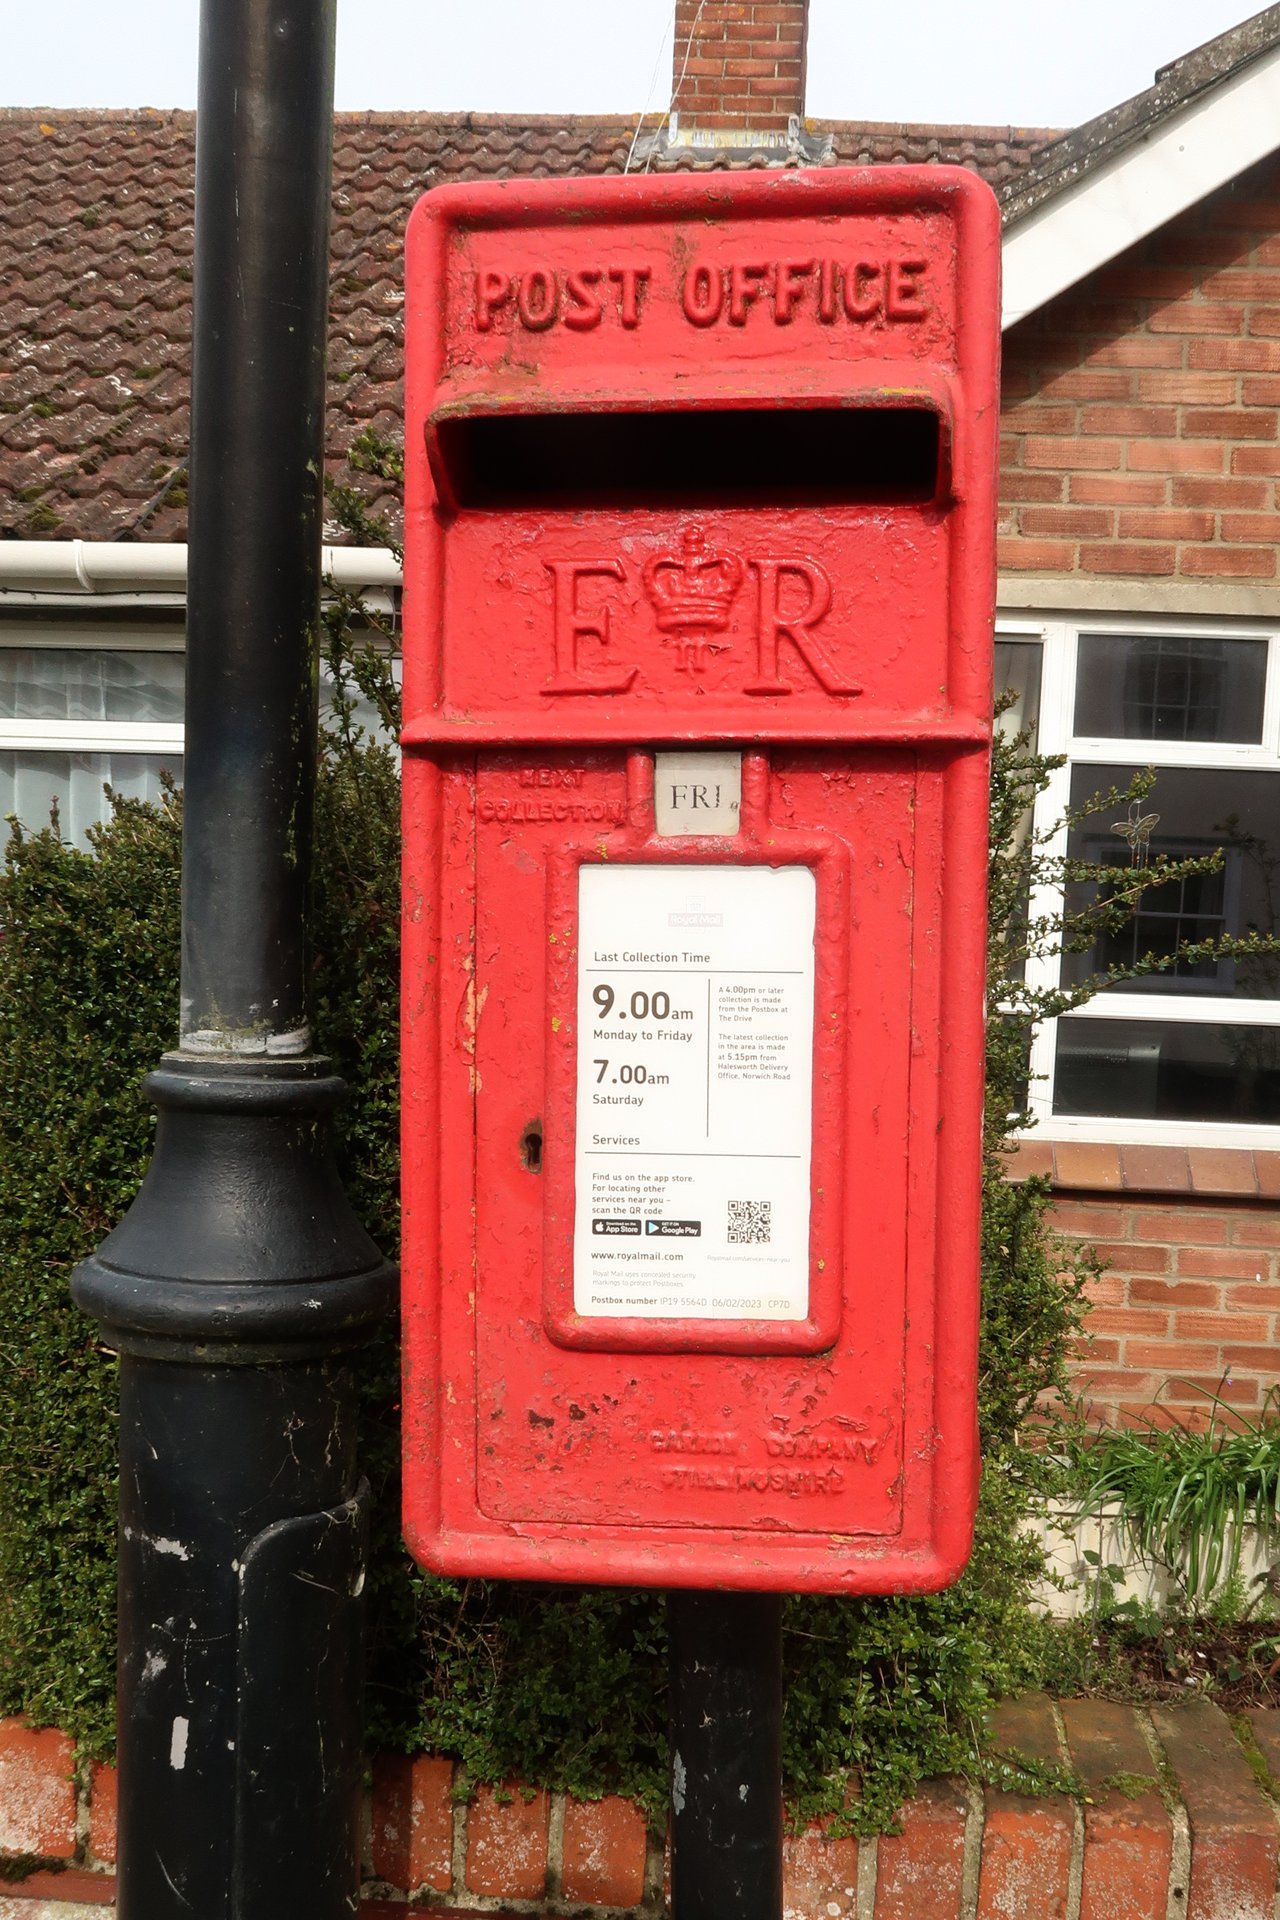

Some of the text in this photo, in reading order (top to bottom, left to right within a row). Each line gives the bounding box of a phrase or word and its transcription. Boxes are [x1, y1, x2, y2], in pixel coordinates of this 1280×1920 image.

[475, 258, 930, 333] POST OFFICE
[540, 556, 863, 697] E R
[519, 769, 585, 788] NEXT
[670, 784, 721, 809] FRI
[477, 799, 625, 824] COLLECTION
[594, 952, 711, 963] Last Collection Time
[725, 985, 756, 995] 4.00pm
[592, 984, 694, 1020] 9.00am
[733, 1014, 753, 1022] Drive
[593, 1030, 693, 1042] Monday to Friday
[727, 1052, 758, 1062] 5.15pm
[592, 1059, 670, 1085] 7.00am
[760, 1063, 788, 1072] Delivery
[742, 1072, 771, 1080] Norwich
[592, 1094, 644, 1106] Saturday
[592, 1134, 641, 1146] Services
[592, 1172, 610, 1181] Find
[638, 1174, 652, 1182] the
[672, 1175, 696, 1183] store.
[592, 1184, 666, 1194] For locating other
[592, 1195, 626, 1203] services
[648, 1197, 664, 1205] you
[613, 1206, 627, 1214] the
[629, 1206, 641, 1215] QR
[644, 1206, 663, 1215] code
[662, 1227, 698, 1235] Google Play
[591, 1252, 684, 1261] www.royalmail.com
[592, 1270, 610, 1278] Royal
[610, 1270, 624, 1278] Mail
[672, 1272, 697, 1280] security
[592, 1279, 620, 1287] markings
[630, 1280, 652, 1288] protect
[591, 1296, 623, 1304] Postbox
[626, 1297, 657, 1305] number
[660, 1297, 679, 1306] IP19
[712, 1298, 762, 1309] 06/02/2023
